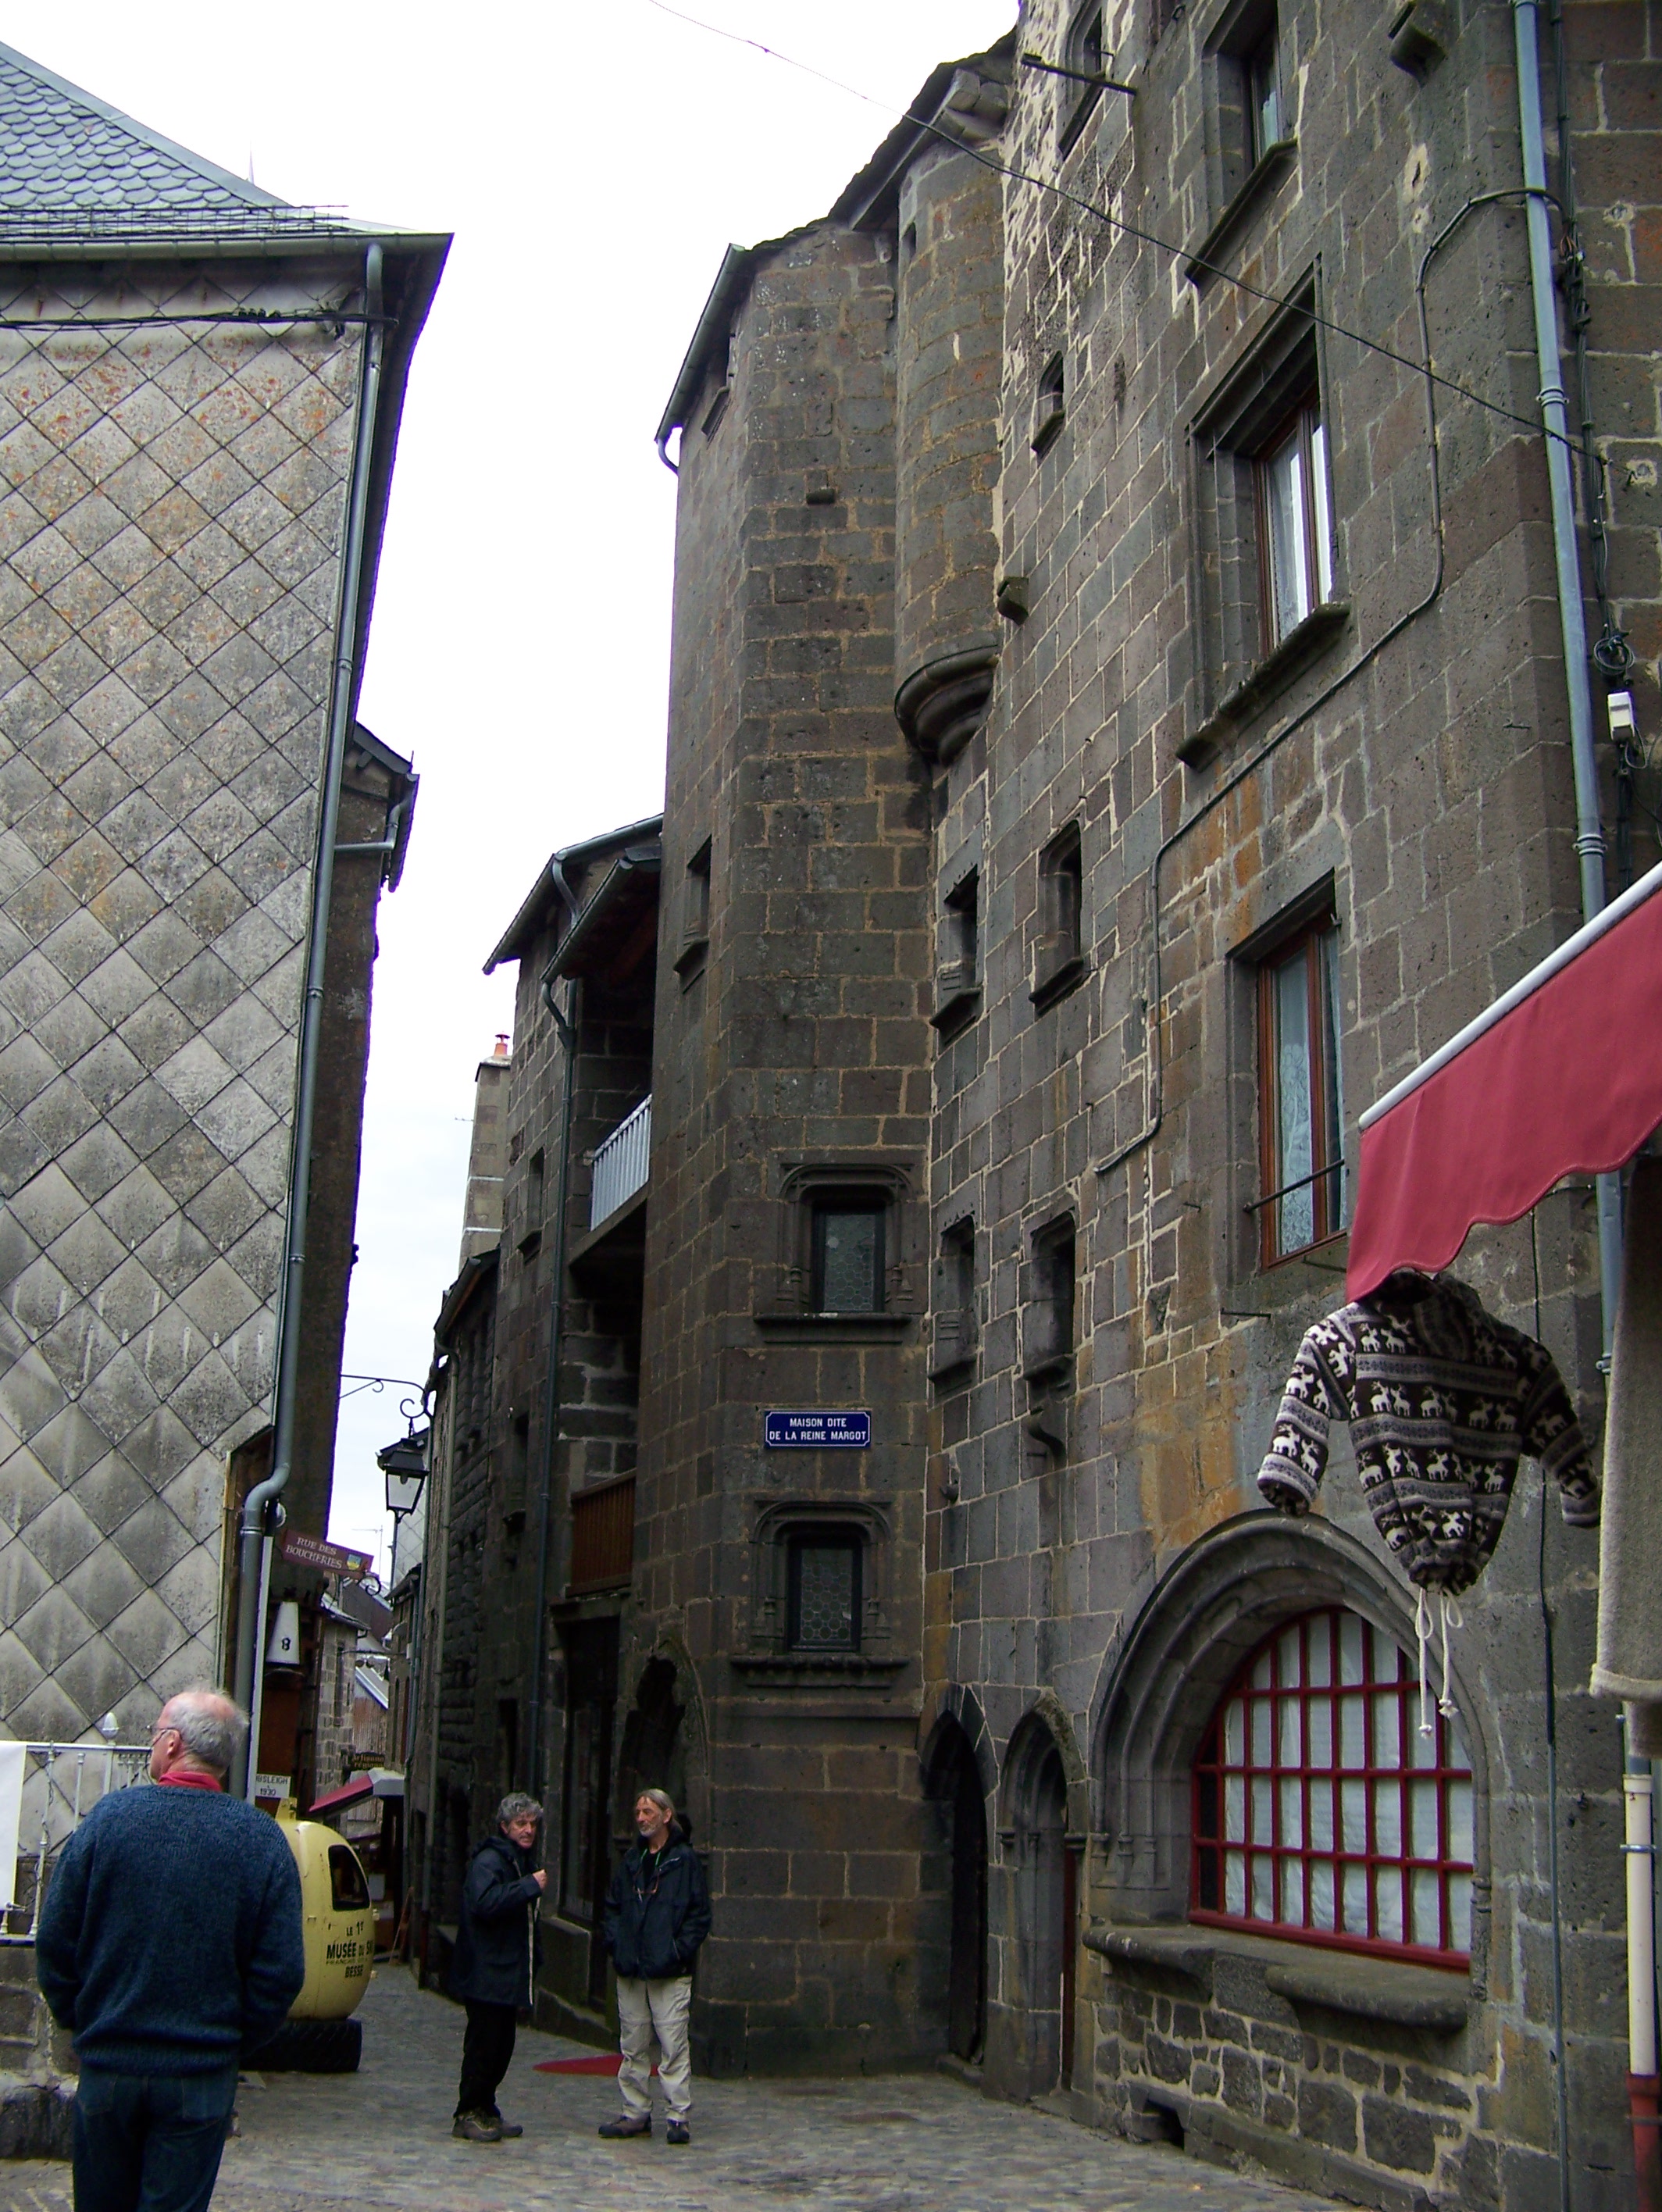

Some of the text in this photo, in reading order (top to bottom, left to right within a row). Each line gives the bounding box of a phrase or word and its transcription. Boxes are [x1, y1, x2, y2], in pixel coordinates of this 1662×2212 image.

[790, 1418, 847, 1427] MAISON DITE
[769, 1431, 866, 1440] DE LA REINE MARGOT
[296, 1537, 337, 1555] RUE DES
[285, 1544, 343, 1569] BOUCHERIES
[282, 1637, 291, 1651] 8
[326, 1939, 357, 1959] MUSÉE
[344, 1964, 363, 1978] BESSE
